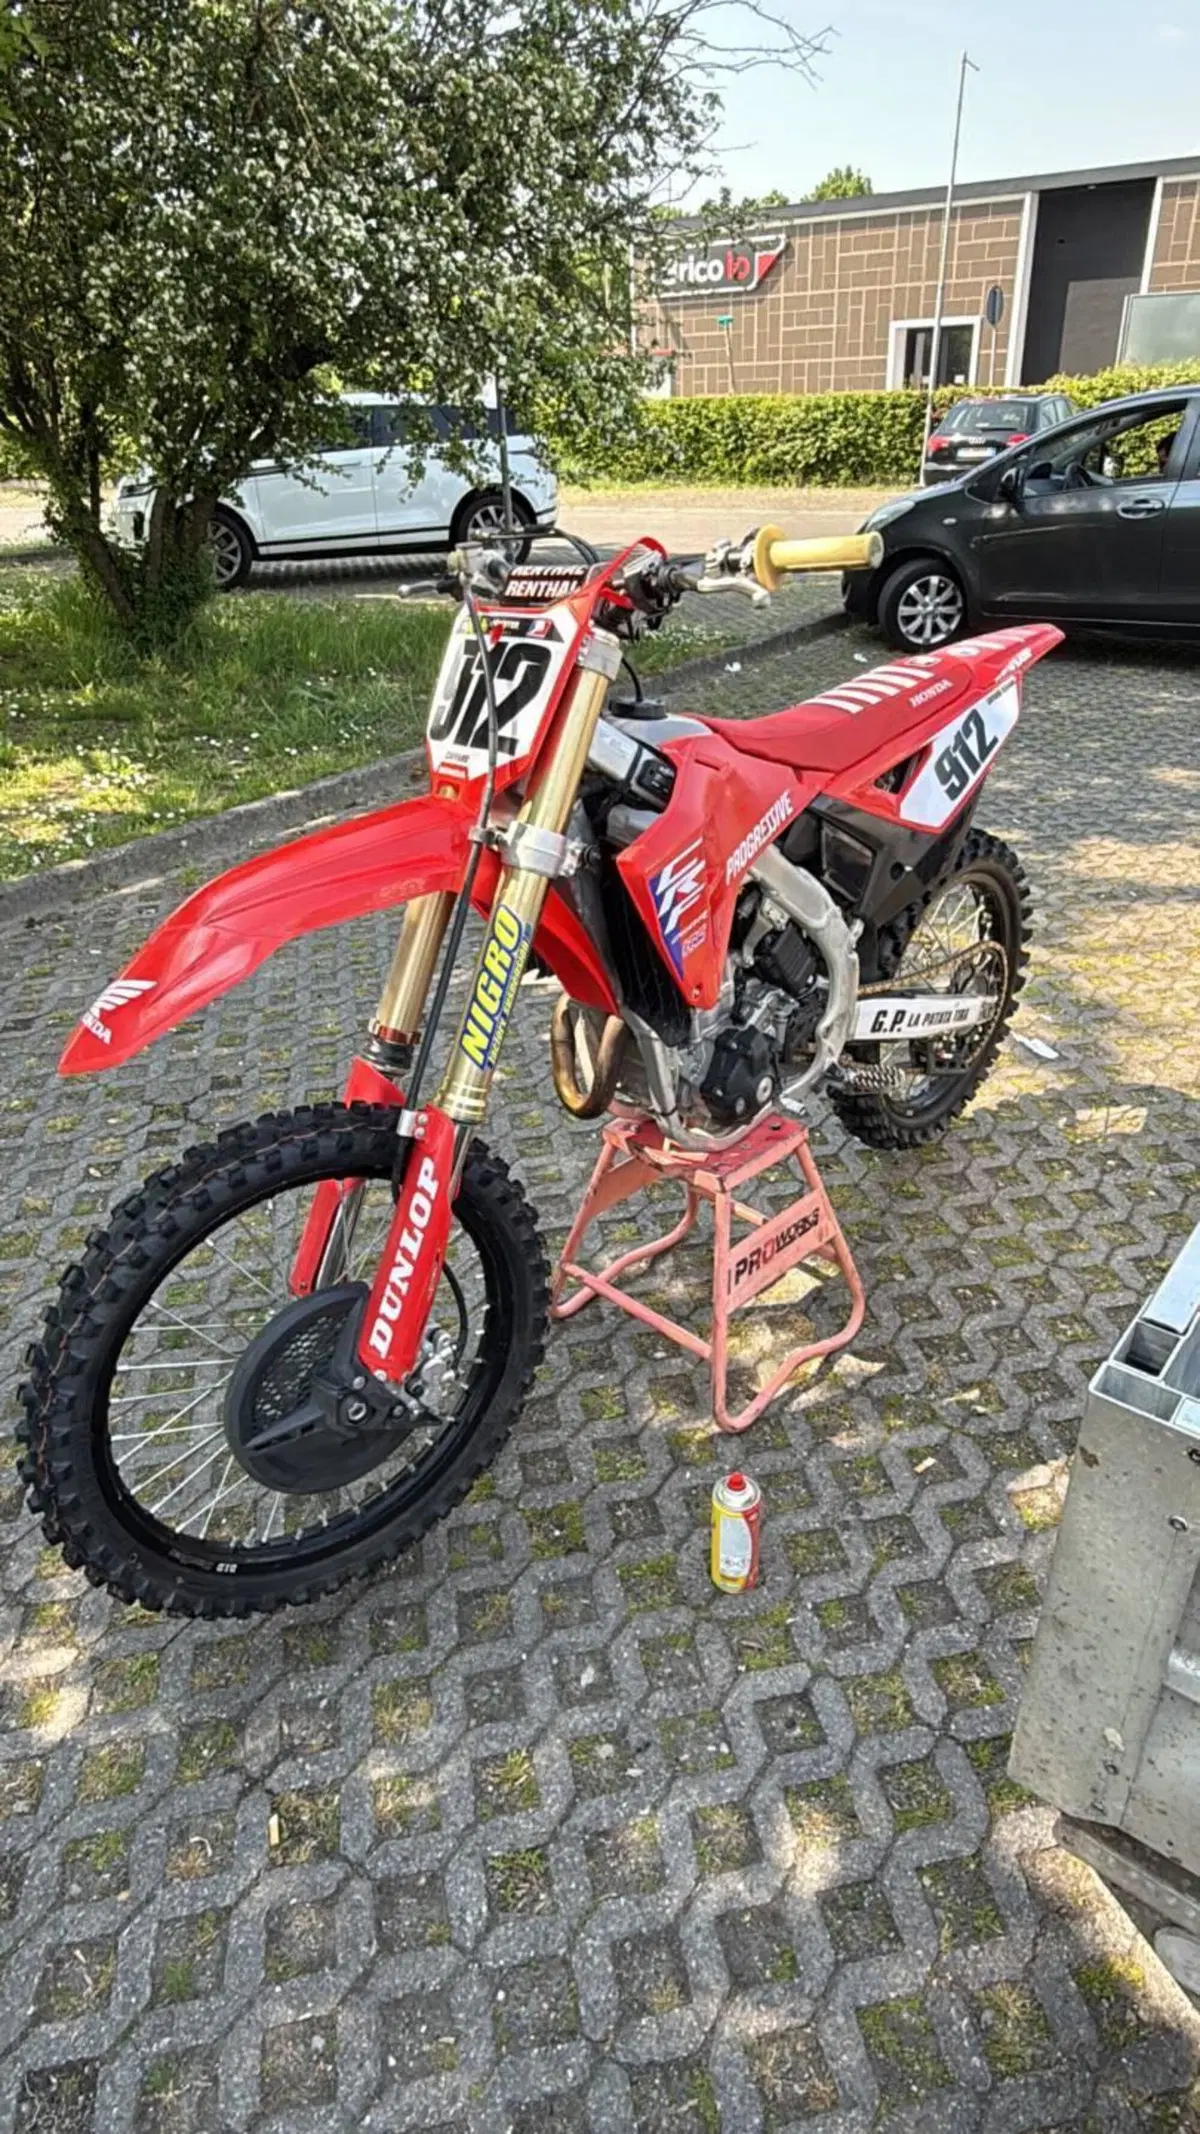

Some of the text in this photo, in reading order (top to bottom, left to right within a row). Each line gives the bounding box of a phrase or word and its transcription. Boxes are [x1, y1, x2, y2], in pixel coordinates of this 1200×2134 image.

[910, 679, 954, 708] HONDA
[934, 708, 999, 801] 912
[460, 904, 521, 1069] NIGRO
[870, 1009, 906, 1034] G.P.
[907, 1013, 921, 1028] LA
[368, 1156, 440, 1360] DUNLOP
